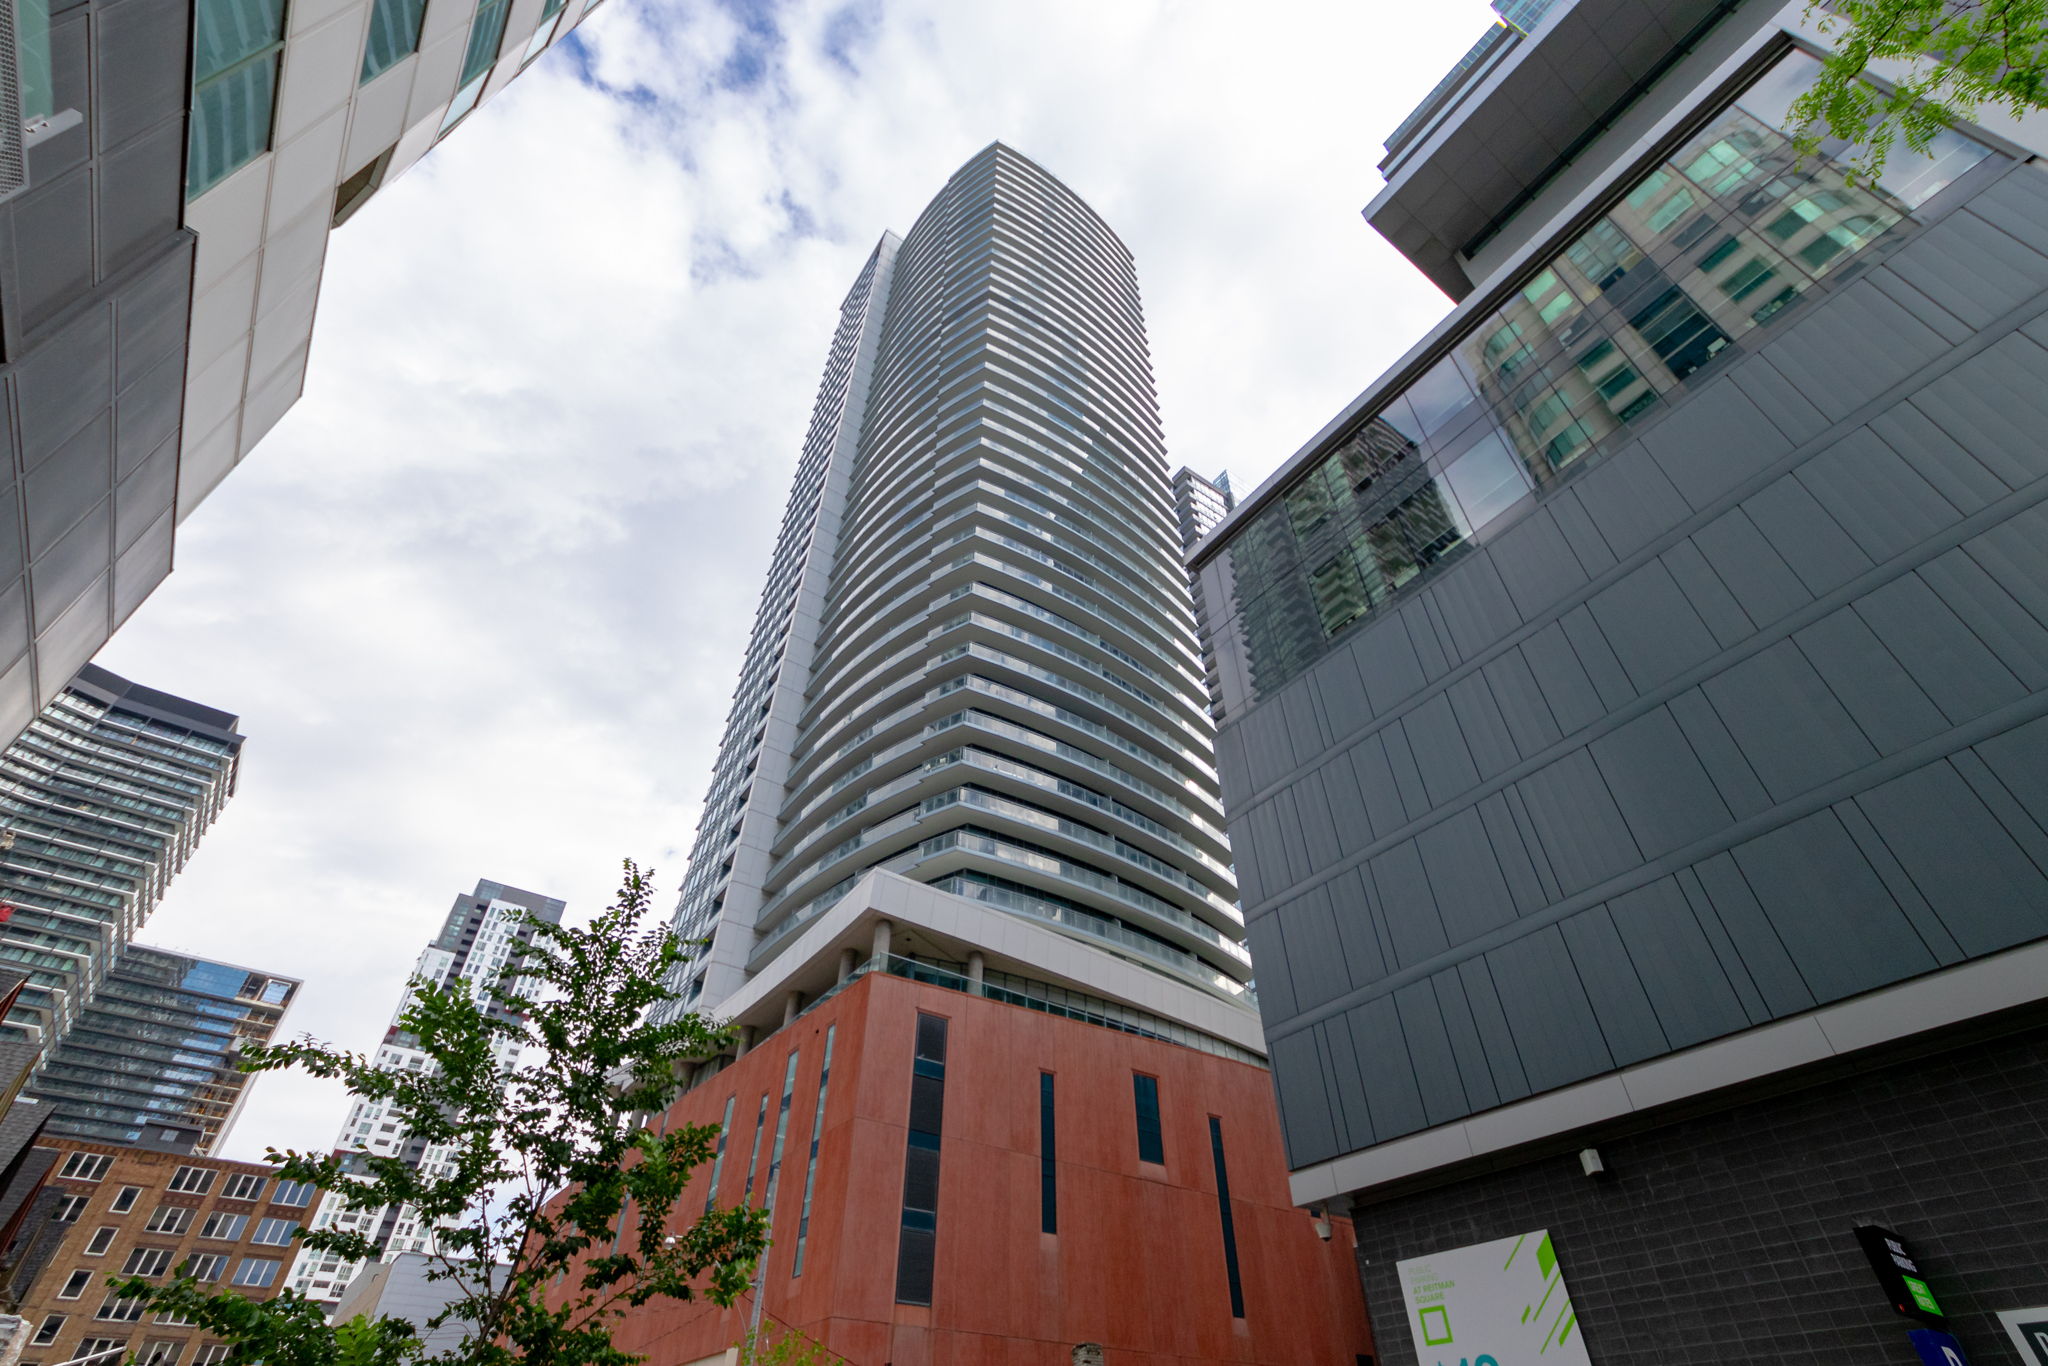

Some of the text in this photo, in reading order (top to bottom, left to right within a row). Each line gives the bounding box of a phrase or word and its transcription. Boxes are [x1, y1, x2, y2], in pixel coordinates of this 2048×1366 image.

[1413, 1280, 1455, 1295] AT REITMAN
[1415, 1292, 1445, 1304] SQUARE
